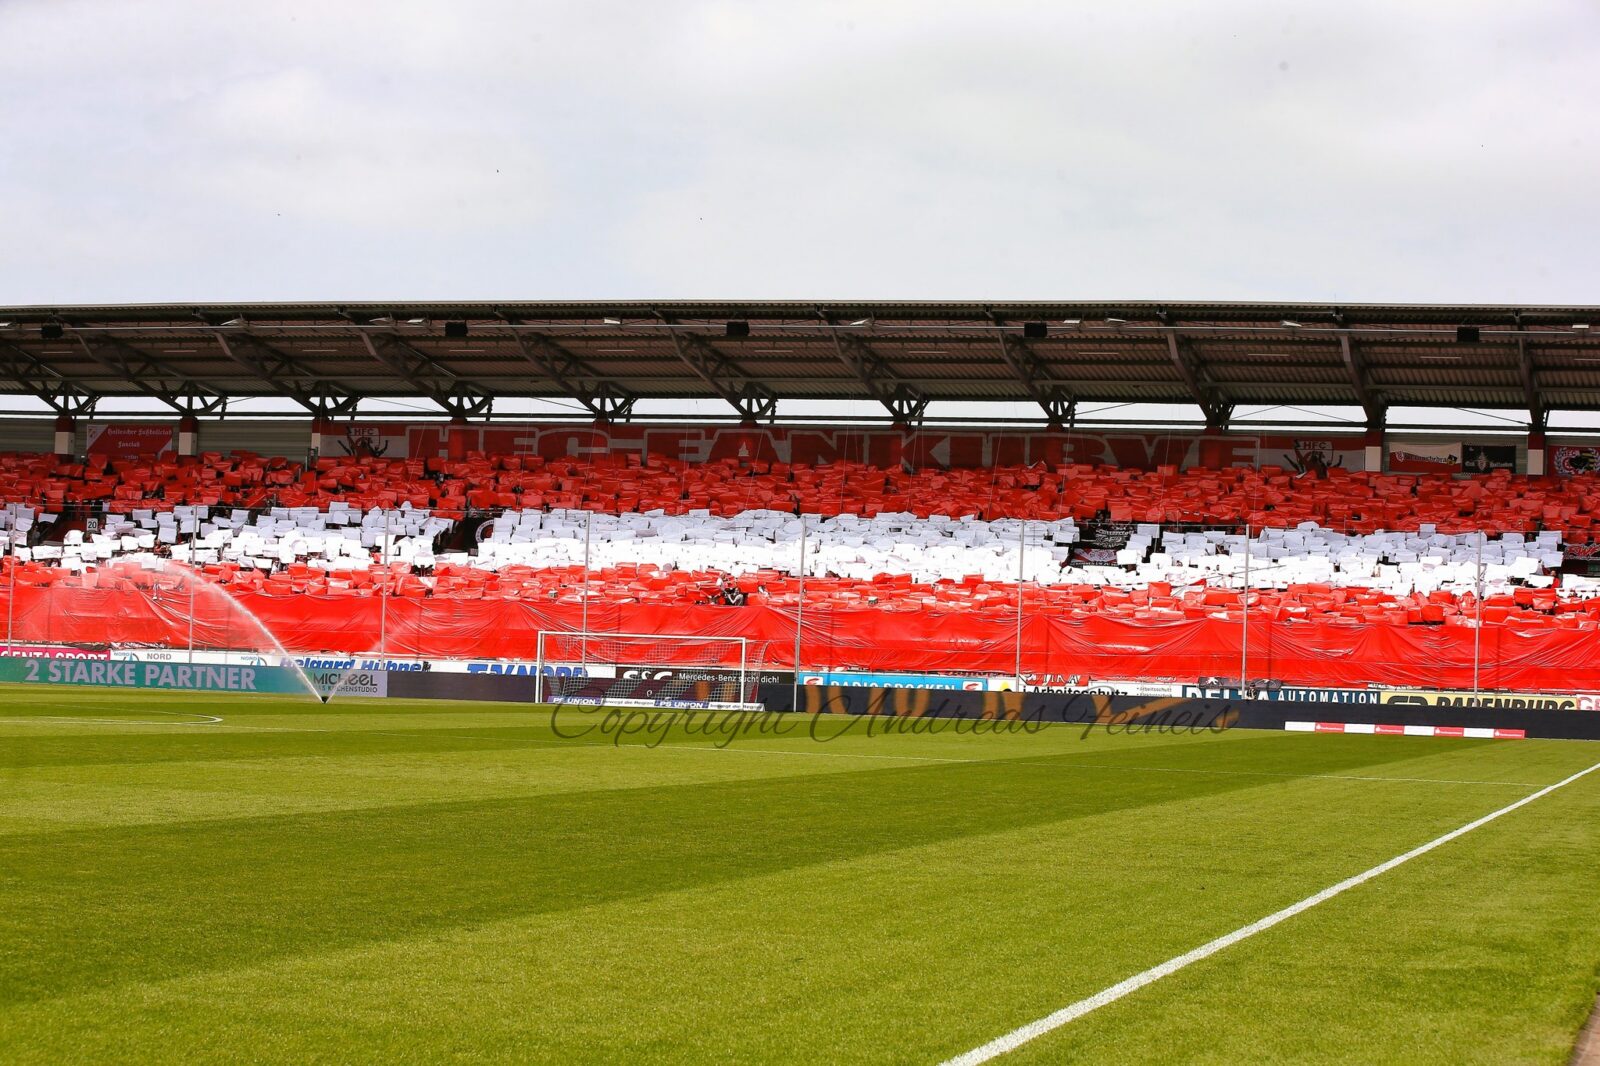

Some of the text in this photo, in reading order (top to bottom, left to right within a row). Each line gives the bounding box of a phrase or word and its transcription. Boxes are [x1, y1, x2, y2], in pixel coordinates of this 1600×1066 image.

[354, 428, 375, 437] HFC
[1303, 440, 1328, 450] HFC
[87, 520, 97, 530] 20
[147, 652, 172, 661] NORD
[25, 660, 257, 690] 2 STARKE PARTNER
[679, 672, 736, 682] Mercedes-Benz
[761, 675, 780, 684] dich!
[1278, 690, 1378, 704] AUTOMATION
